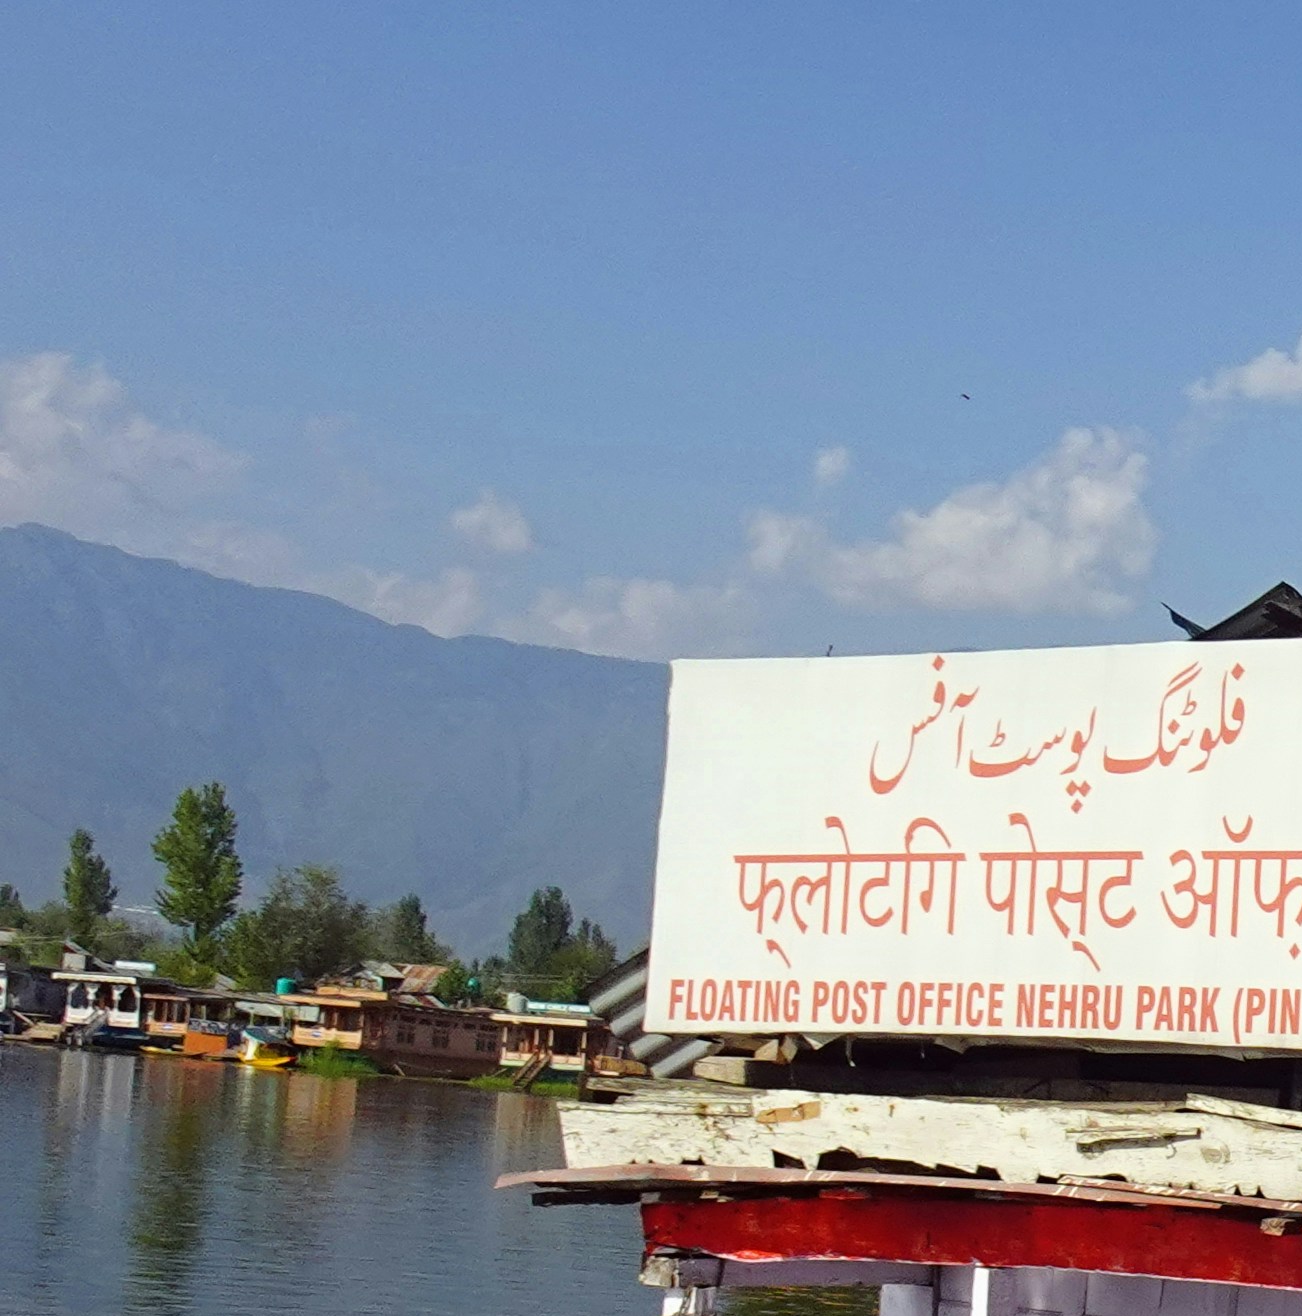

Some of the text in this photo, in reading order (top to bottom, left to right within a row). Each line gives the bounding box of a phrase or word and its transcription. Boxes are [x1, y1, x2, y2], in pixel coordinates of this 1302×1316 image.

[868, 655, 981, 796] آفس
[968, 706, 1098, 814] پوسٹ
[667, 977, 801, 1025] FLOATING
[809, 979, 889, 1026] POST
[895, 980, 1006, 1029] OFFICE
[1015, 983, 1125, 1032] NEHRU
[1135, 985, 1222, 1034] PARK
